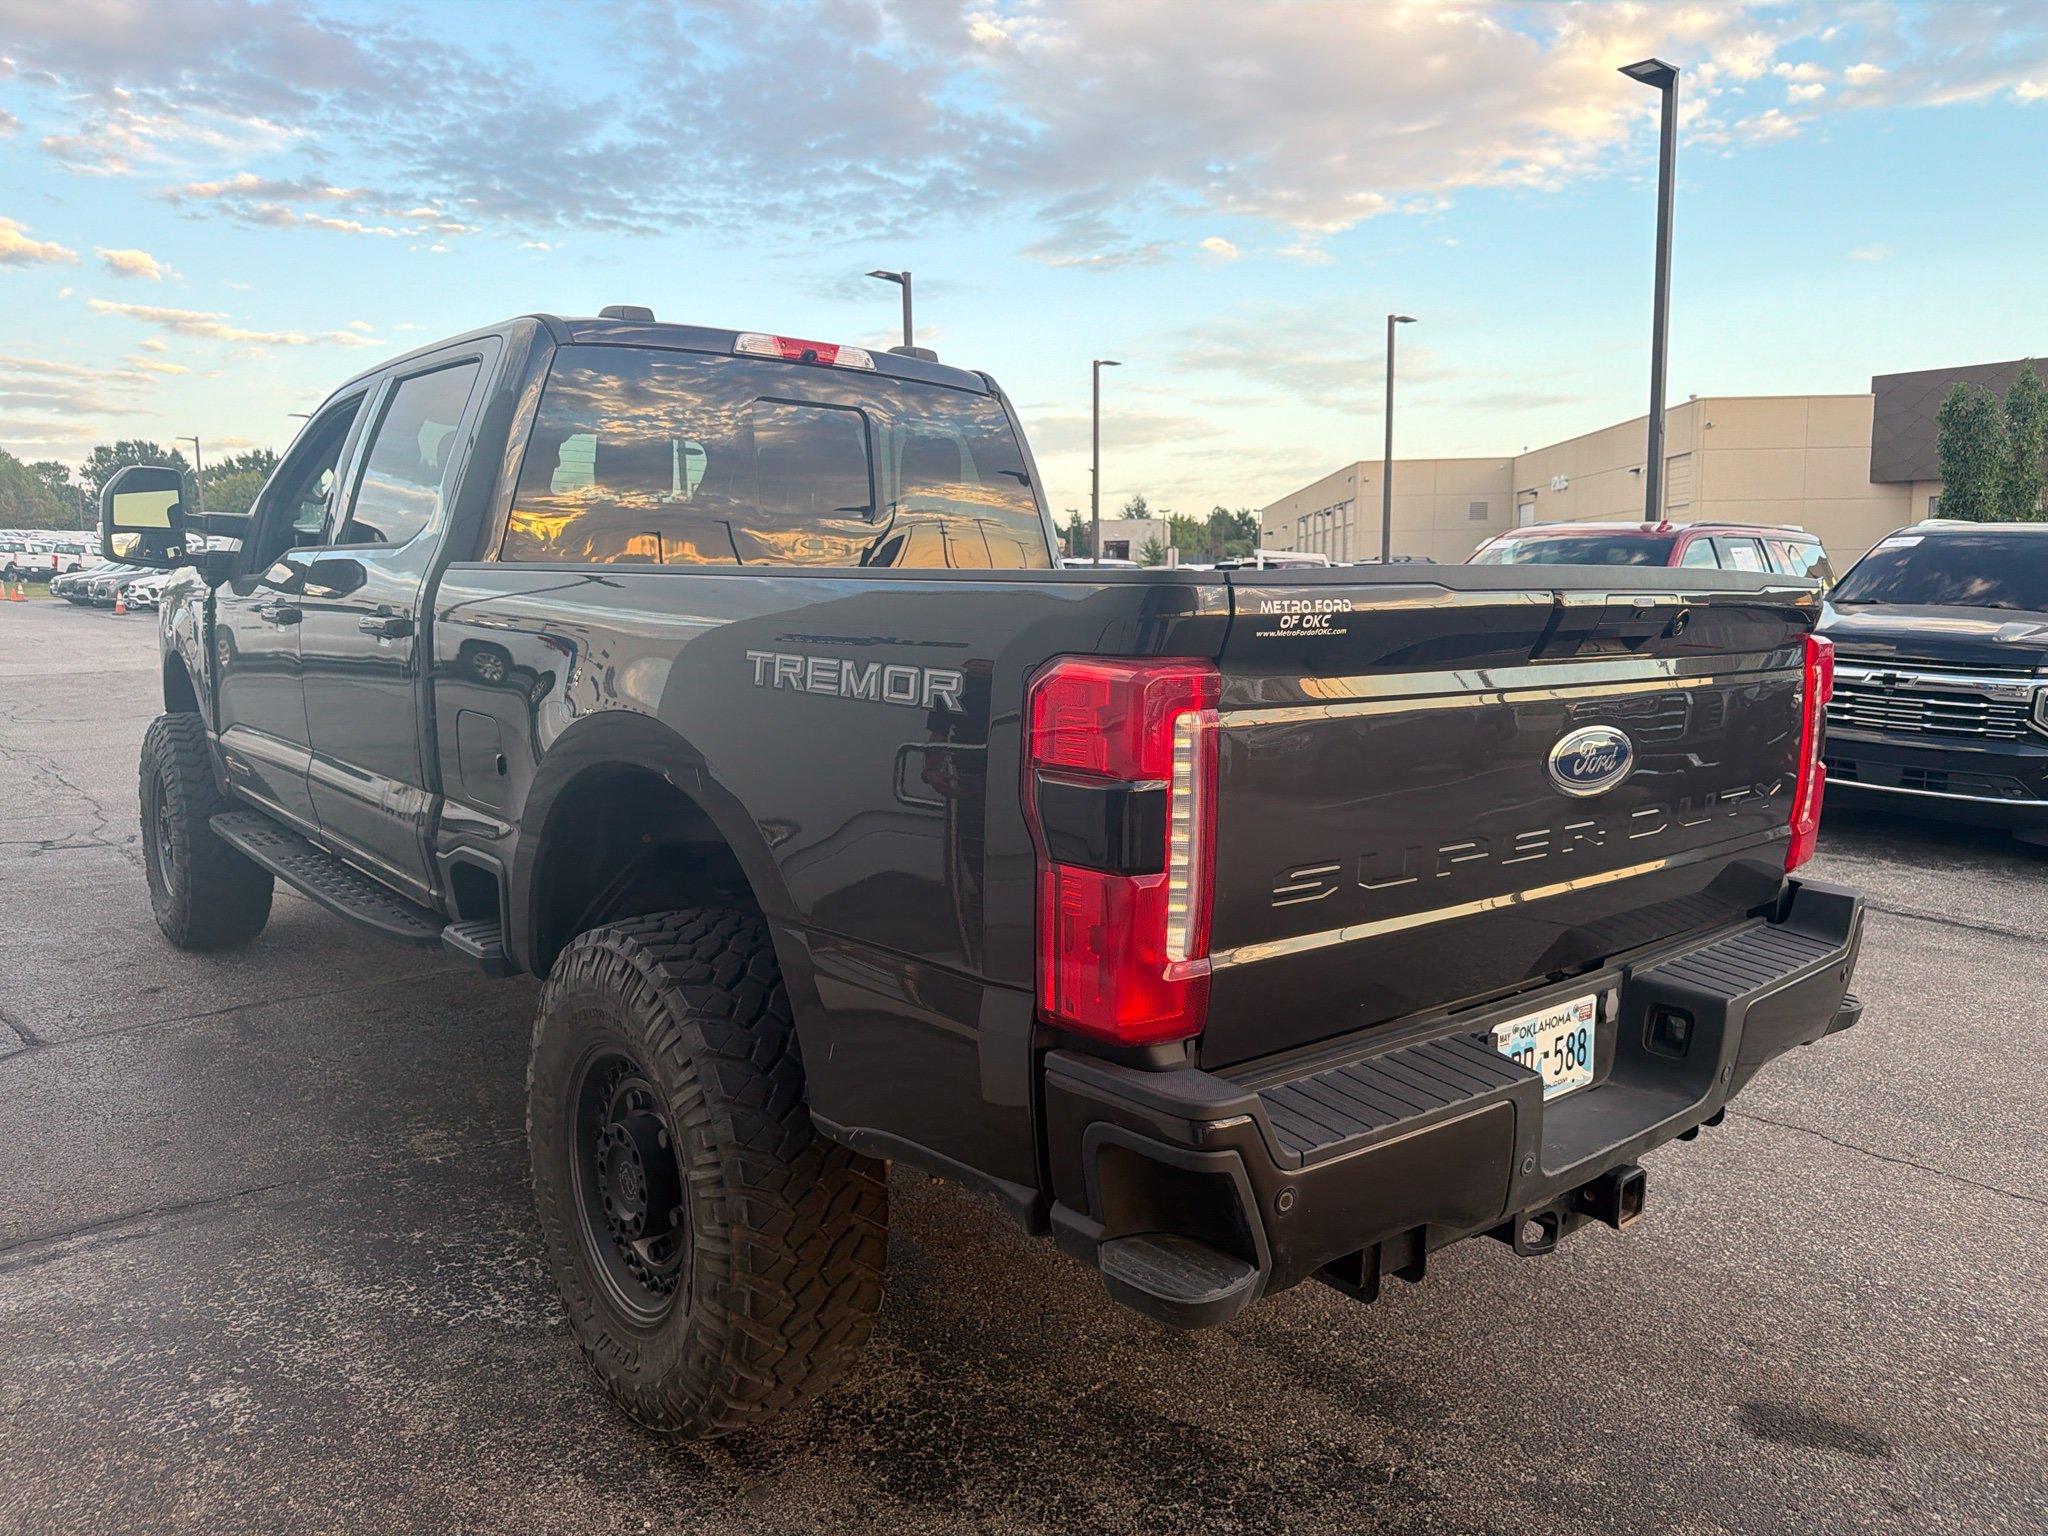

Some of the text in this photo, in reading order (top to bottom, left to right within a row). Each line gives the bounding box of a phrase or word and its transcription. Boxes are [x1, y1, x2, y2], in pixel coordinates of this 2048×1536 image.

[1260, 598, 1353, 614] METRO FORD
[1256, 628, 1347, 637] www.MetroFordofOKC.com
[1280, 614, 1332, 629] OF OKC
[746, 649, 968, 714] TREMOR
[1573, 740, 1619, 776] Ford
[1271, 778, 1783, 907] SUPER DUTY
[1519, 1011, 1572, 1039] OKLAHOMA
